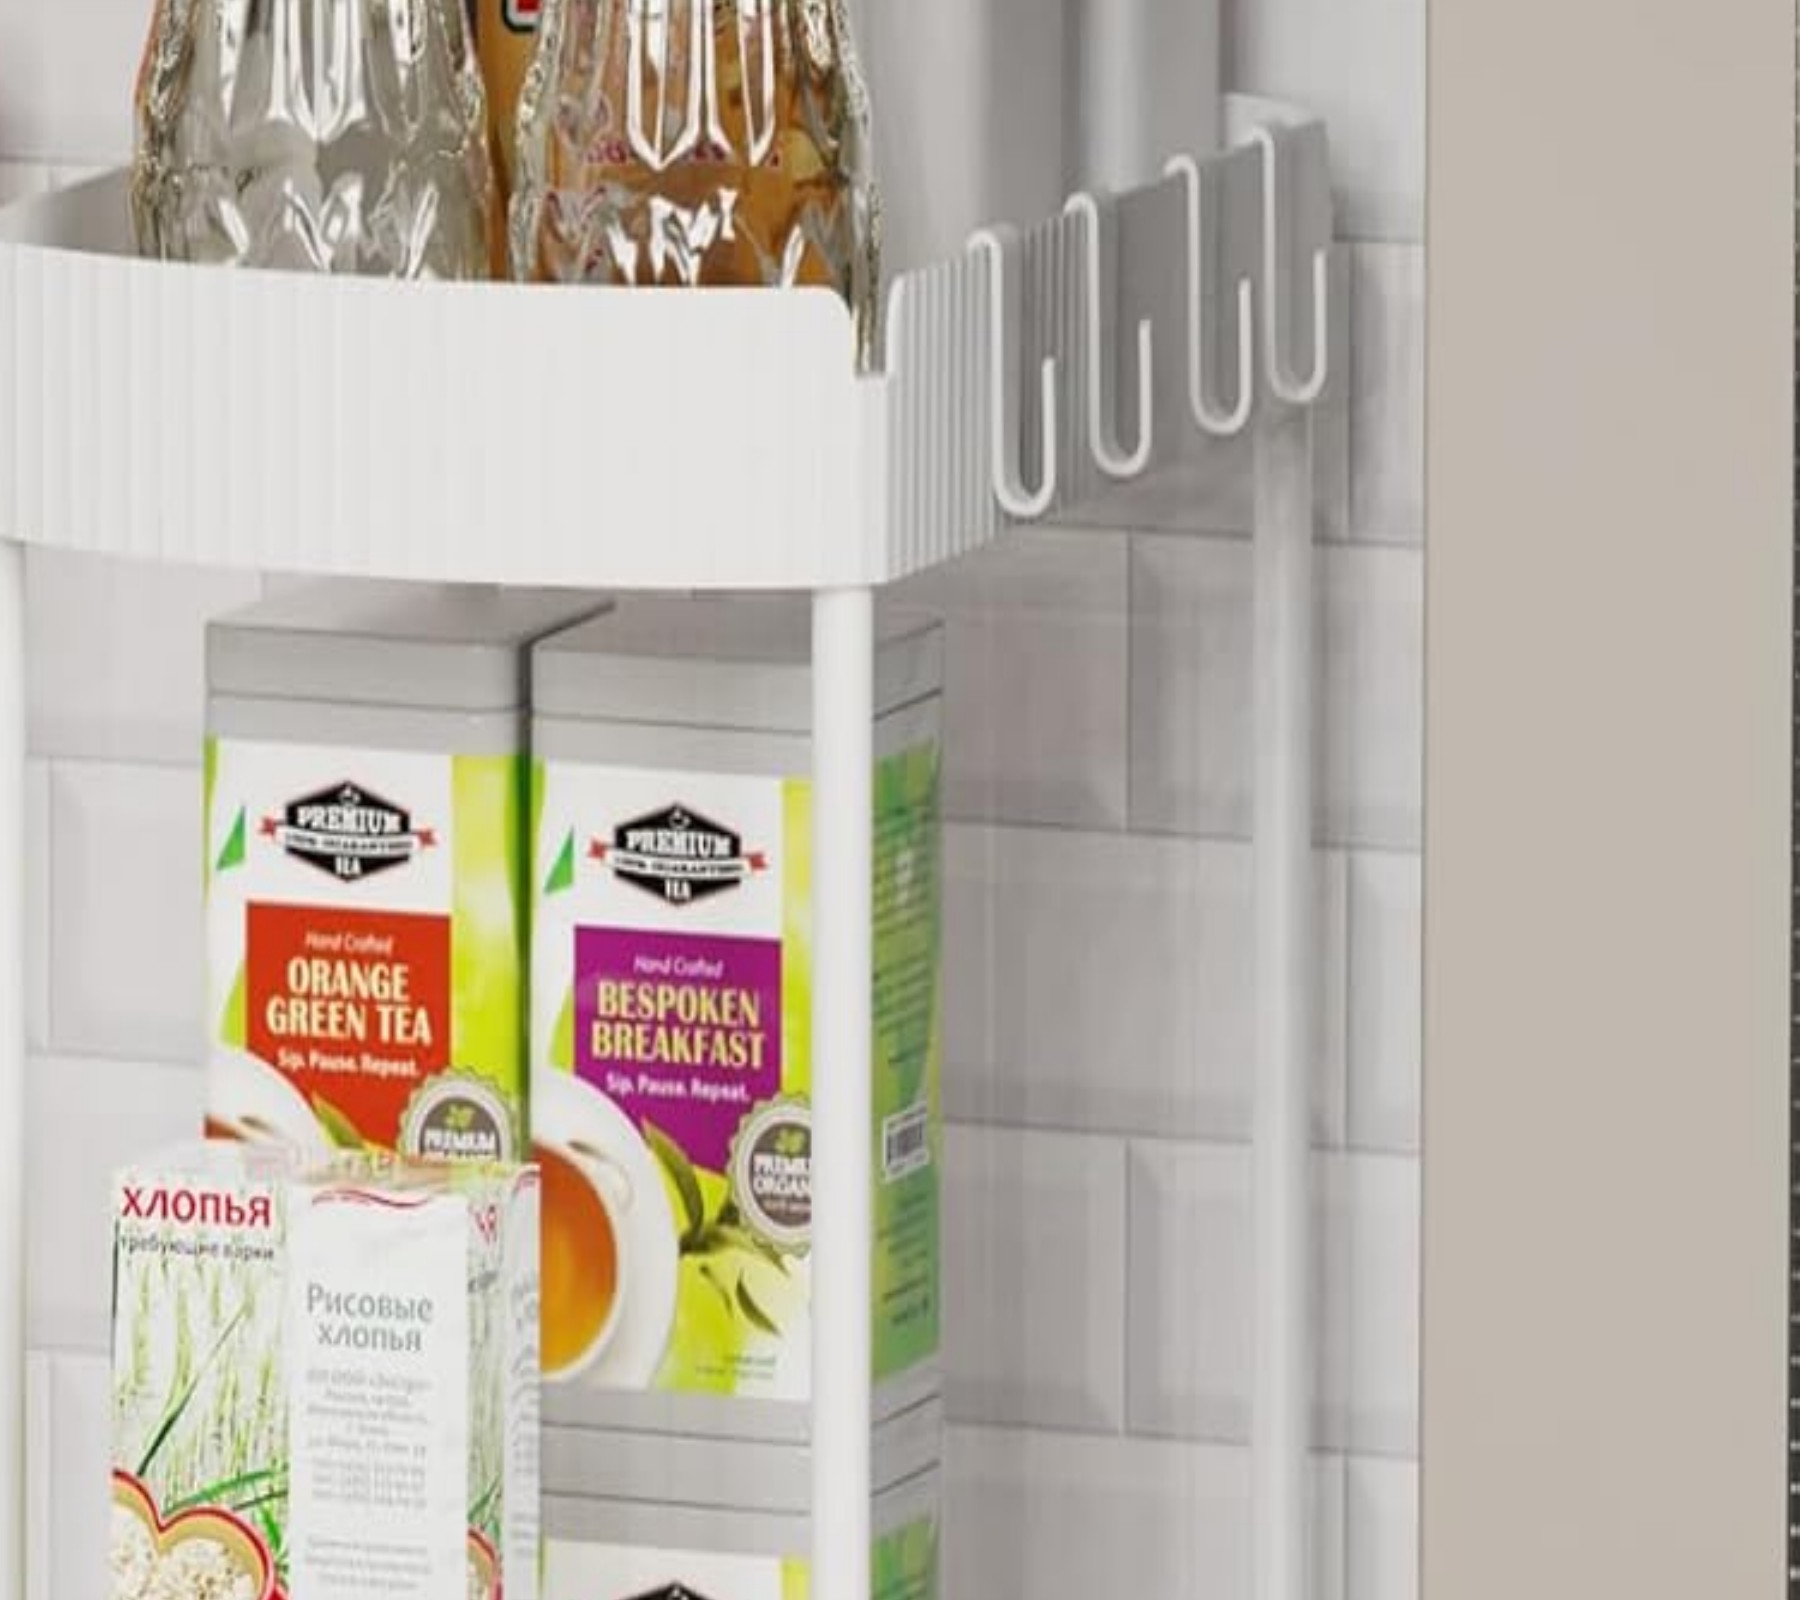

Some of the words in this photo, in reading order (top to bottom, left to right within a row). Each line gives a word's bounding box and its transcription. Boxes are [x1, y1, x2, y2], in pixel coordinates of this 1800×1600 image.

[296, 805, 401, 834] PREMIUM
[625, 828, 734, 859] PREMIUM
[334, 856, 363, 876] TEA
[664, 880, 692, 900] TEA
[304, 930, 341, 952] Hand
[343, 932, 394, 954] Crafted
[287, 956, 410, 1002] ORANGE
[633, 953, 671, 976] Hand
[673, 956, 724, 979] Crafted
[596, 979, 761, 1029] BESPOKEN
[265, 997, 367, 1042] GREEN
[375, 1004, 433, 1048] TEA
[591, 1020, 767, 1071] BREAKFAST
[309, 1051, 357, 1074] Pause.
[360, 1055, 421, 1080] Repeat.
[637, 1074, 688, 1098] Pause.
[690, 1080, 750, 1104] Repeat.
[306, 1281, 434, 1322] Рисовые
[317, 1321, 423, 1352] хлопья
